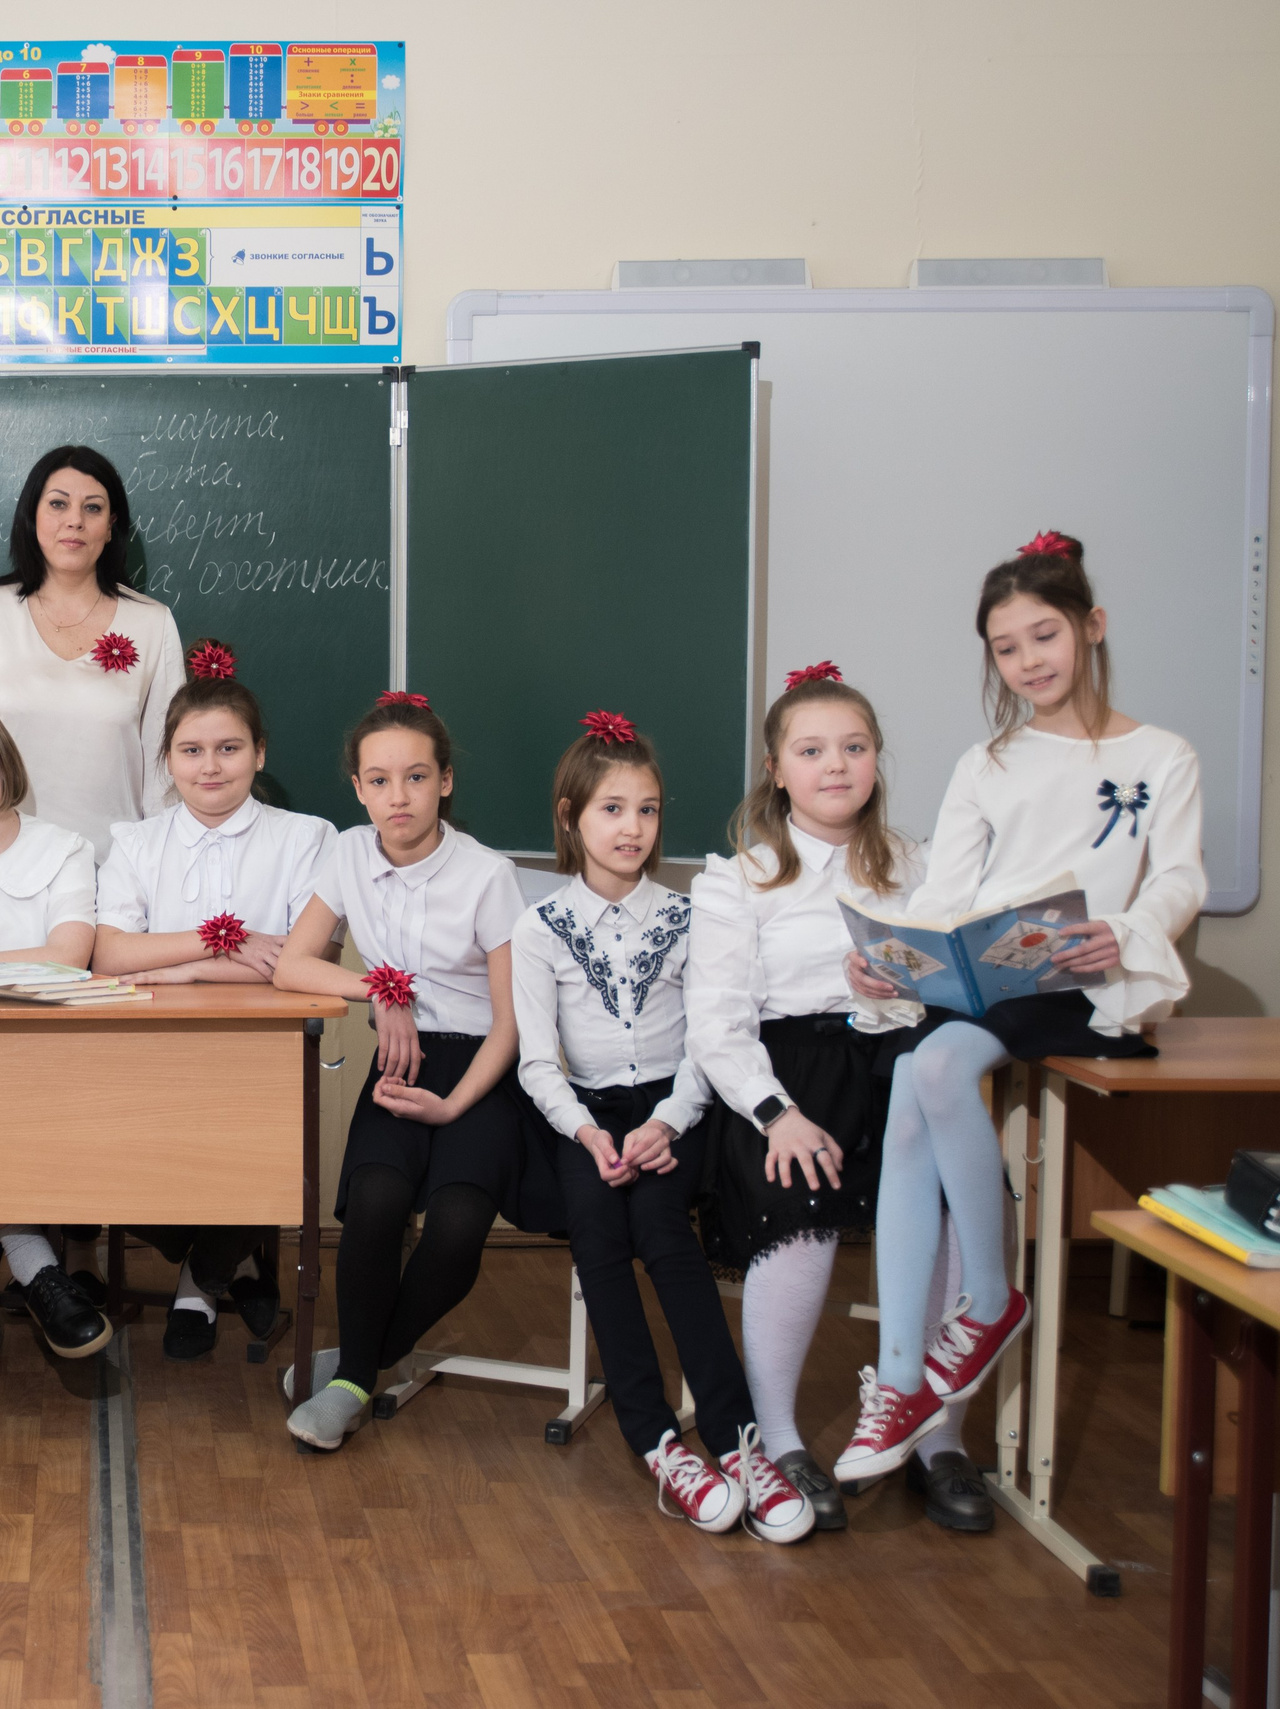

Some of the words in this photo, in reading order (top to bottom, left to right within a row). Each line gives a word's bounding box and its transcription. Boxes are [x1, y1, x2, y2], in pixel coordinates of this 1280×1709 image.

[19, 47, 42, 61] 10
[195, 51, 202, 61] 9
[250, 45, 263, 54] 10
[292, 46, 332, 54] Основные
[332, 47, 371, 55] операции
[80, 63, 87, 72] 7
[136, 56, 144, 66] 8
[23, 70, 30, 79] 6
[323, 91, 364, 99] сравнения
[18, 147, 52, 190] 11
[55, 147, 91, 190] 12
[93, 147, 129, 190] 13
[132, 147, 165, 190] 14
[170, 147, 206, 190] 15
[208, 147, 244, 190] 16
[247, 147, 284, 190] 17
[285, 147, 321, 190] 18
[325, 147, 360, 190] 19
[363, 147, 399, 191] 20
[1, 209, 146, 226] СОГЛАСНЫЕ
[21, 238, 48, 277] В
[61, 238, 83, 277] Г
[94, 237, 127, 282] Д
[131, 237, 167, 277] Ж
[174, 237, 200, 277] З
[366, 237, 394, 276] Ь
[18, 295, 51, 336] Ф
[58, 296, 86, 336] К
[96, 296, 125, 335] Т
[132, 295, 165, 336] Ш
[173, 295, 201, 336] С
[210, 296, 241, 335] Х
[248, 296, 280, 342] Ц
[288, 296, 317, 335] Ч
[324, 296, 357, 342] Щ
[363, 296, 396, 335] Ъ
[84, 346, 137, 354] СОГЛАСНЫЕ
[124, 451, 241, 495] бота.
[130, 500, 276, 570] нверт,
